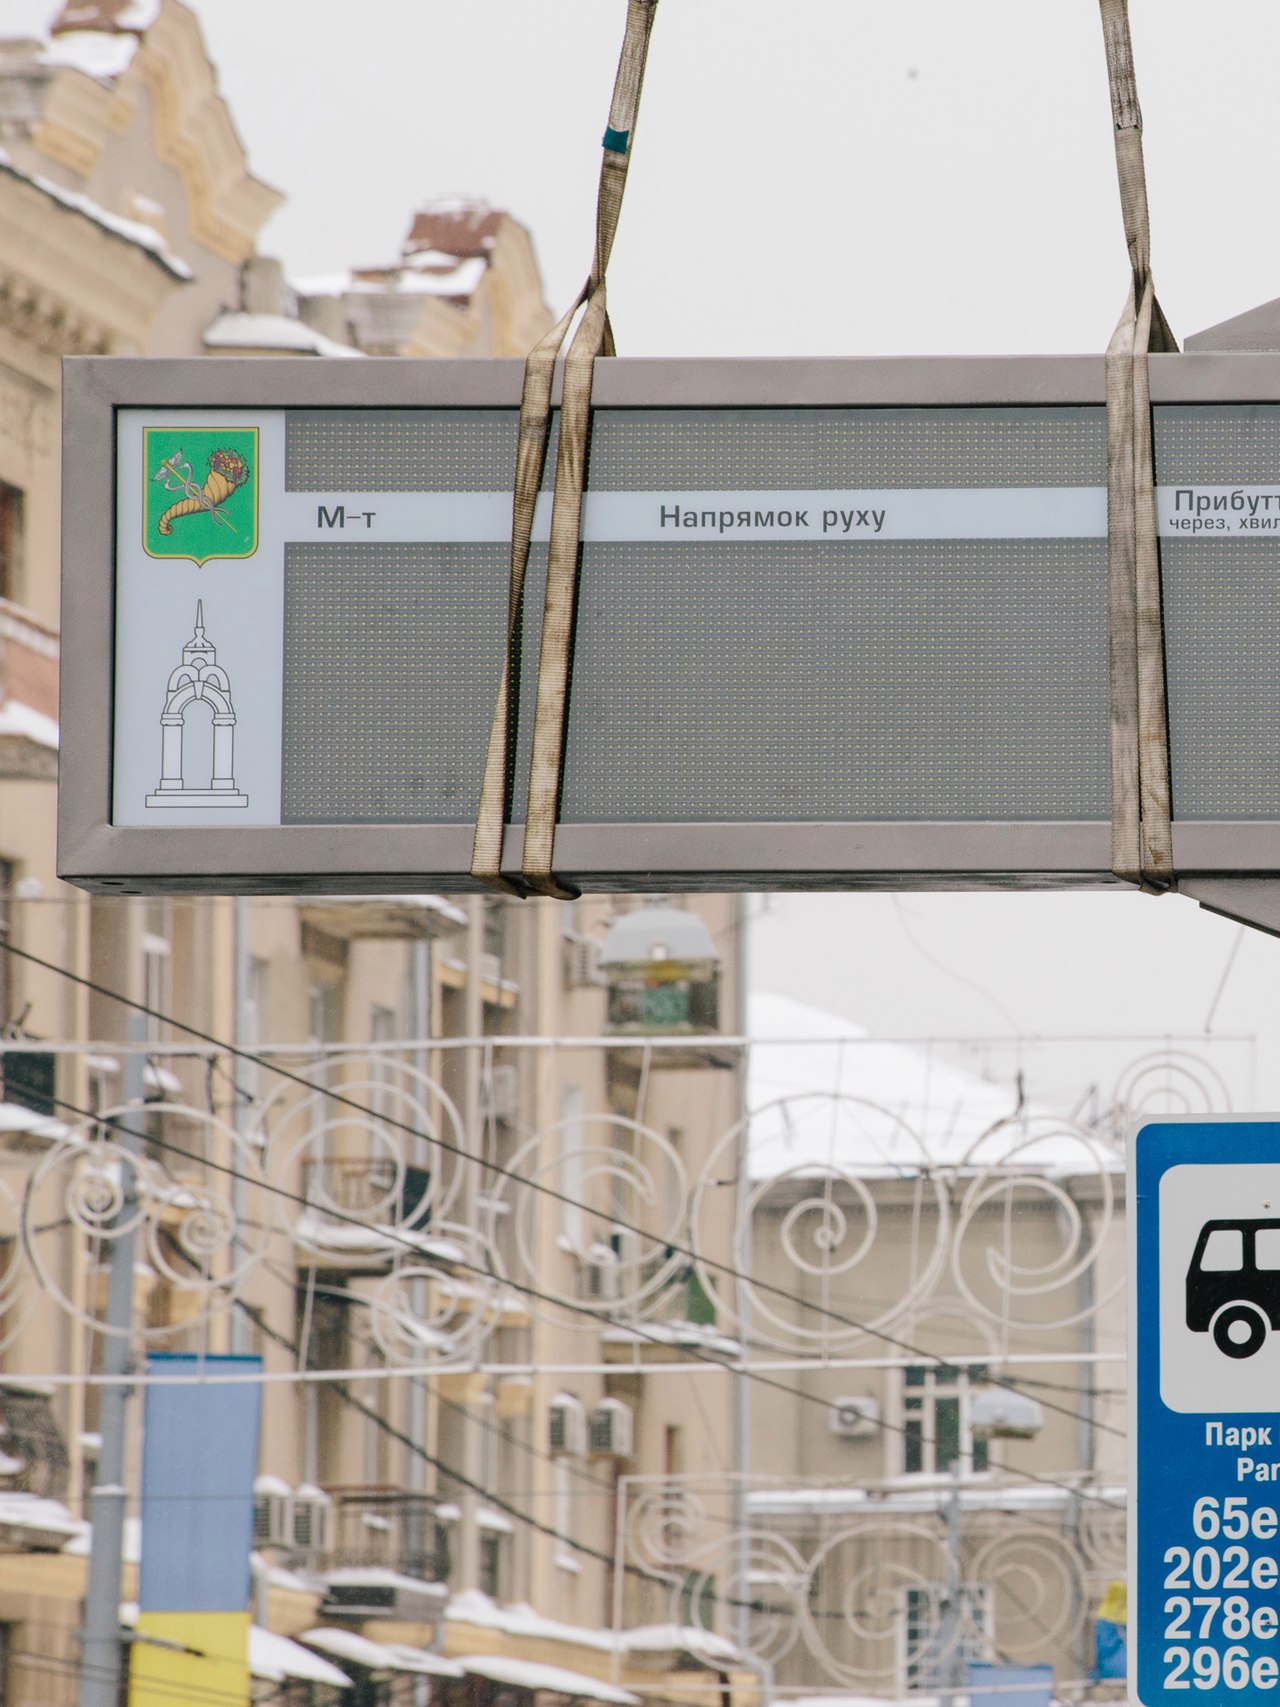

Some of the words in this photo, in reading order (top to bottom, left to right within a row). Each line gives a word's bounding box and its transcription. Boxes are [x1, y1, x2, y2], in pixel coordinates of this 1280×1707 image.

[659, 505, 810, 535] Напрямок
[822, 507, 887, 534] руху
[1170, 519, 1230, 533] через,
[1205, 1422, 1272, 1450] Парк
[1193, 1496, 1278, 1540] 65е
[1163, 1546, 1278, 1590] 202е
[1163, 1596, 1278, 1640] 278е
[1163, 1646, 1278, 1690] 296е
